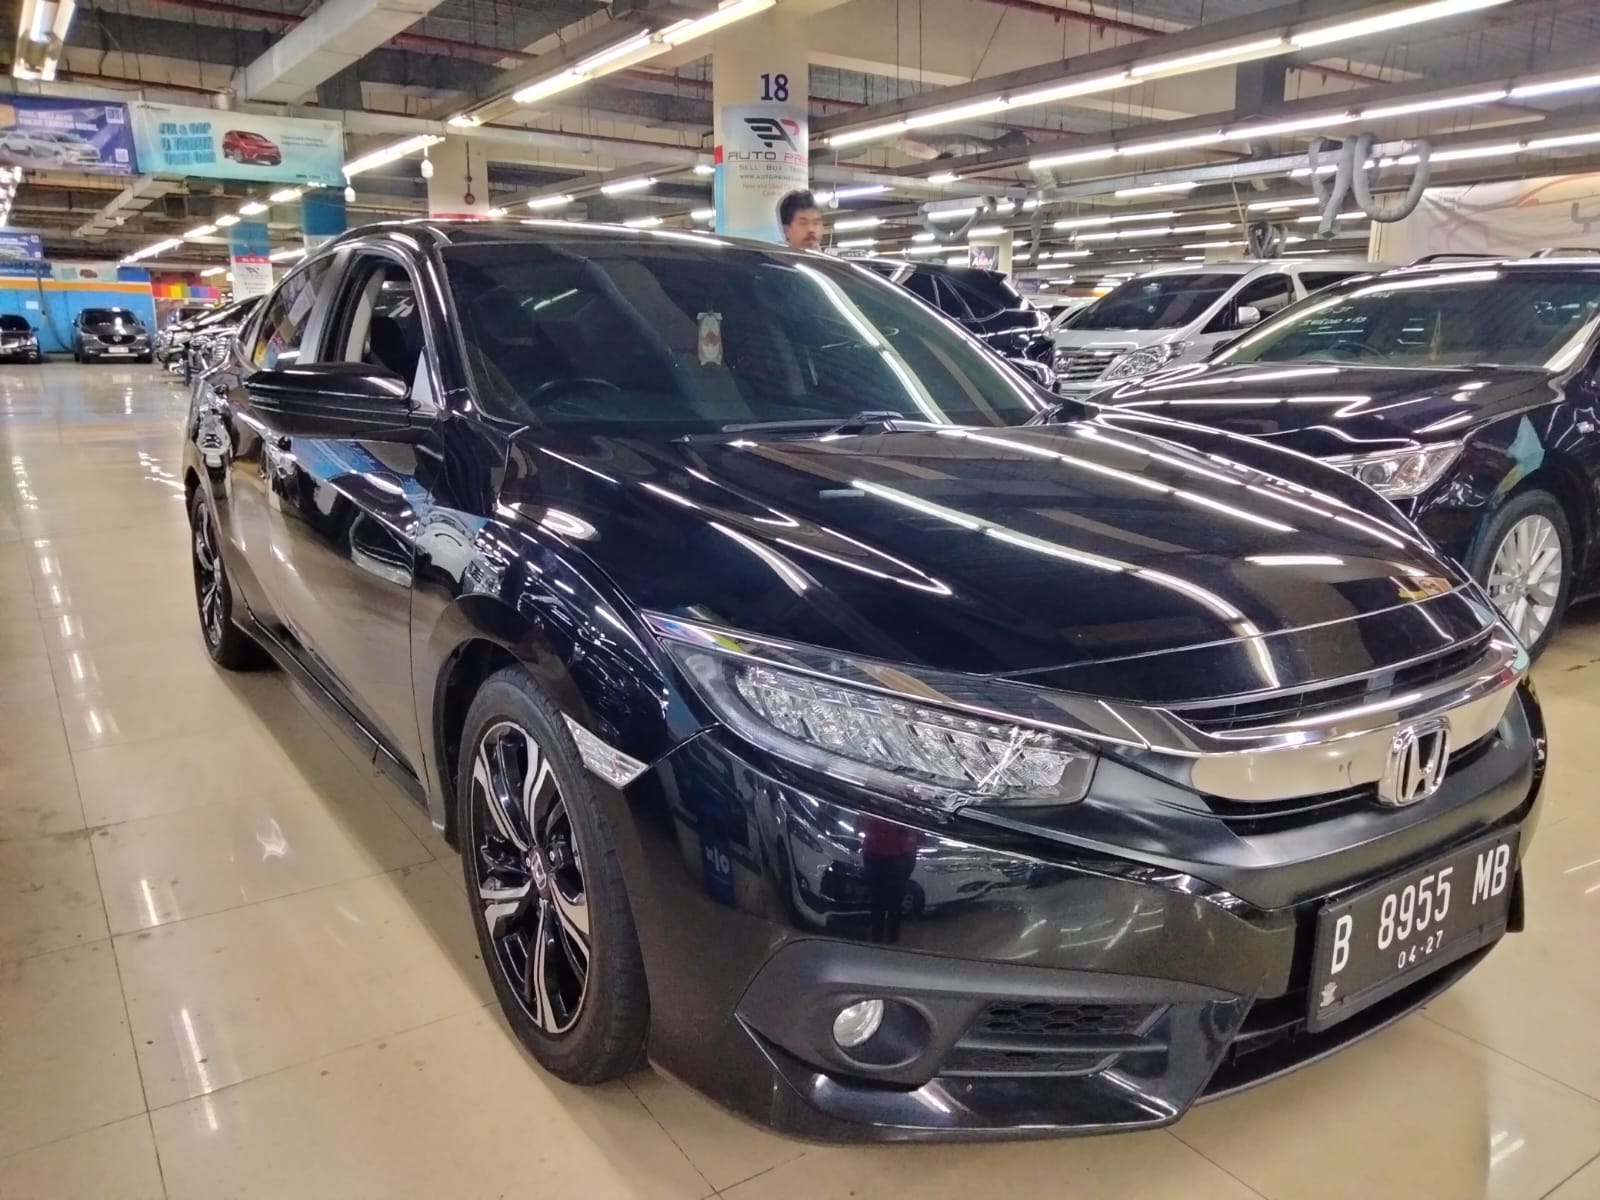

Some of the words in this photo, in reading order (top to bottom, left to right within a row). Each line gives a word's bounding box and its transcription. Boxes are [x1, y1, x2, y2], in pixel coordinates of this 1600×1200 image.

[761, 73, 789, 102] 18
[728, 151, 777, 161] AUTO
[1330, 914, 1353, 976] B
[1377, 867, 1454, 951] 8955
[1471, 843, 1510, 906] MB
